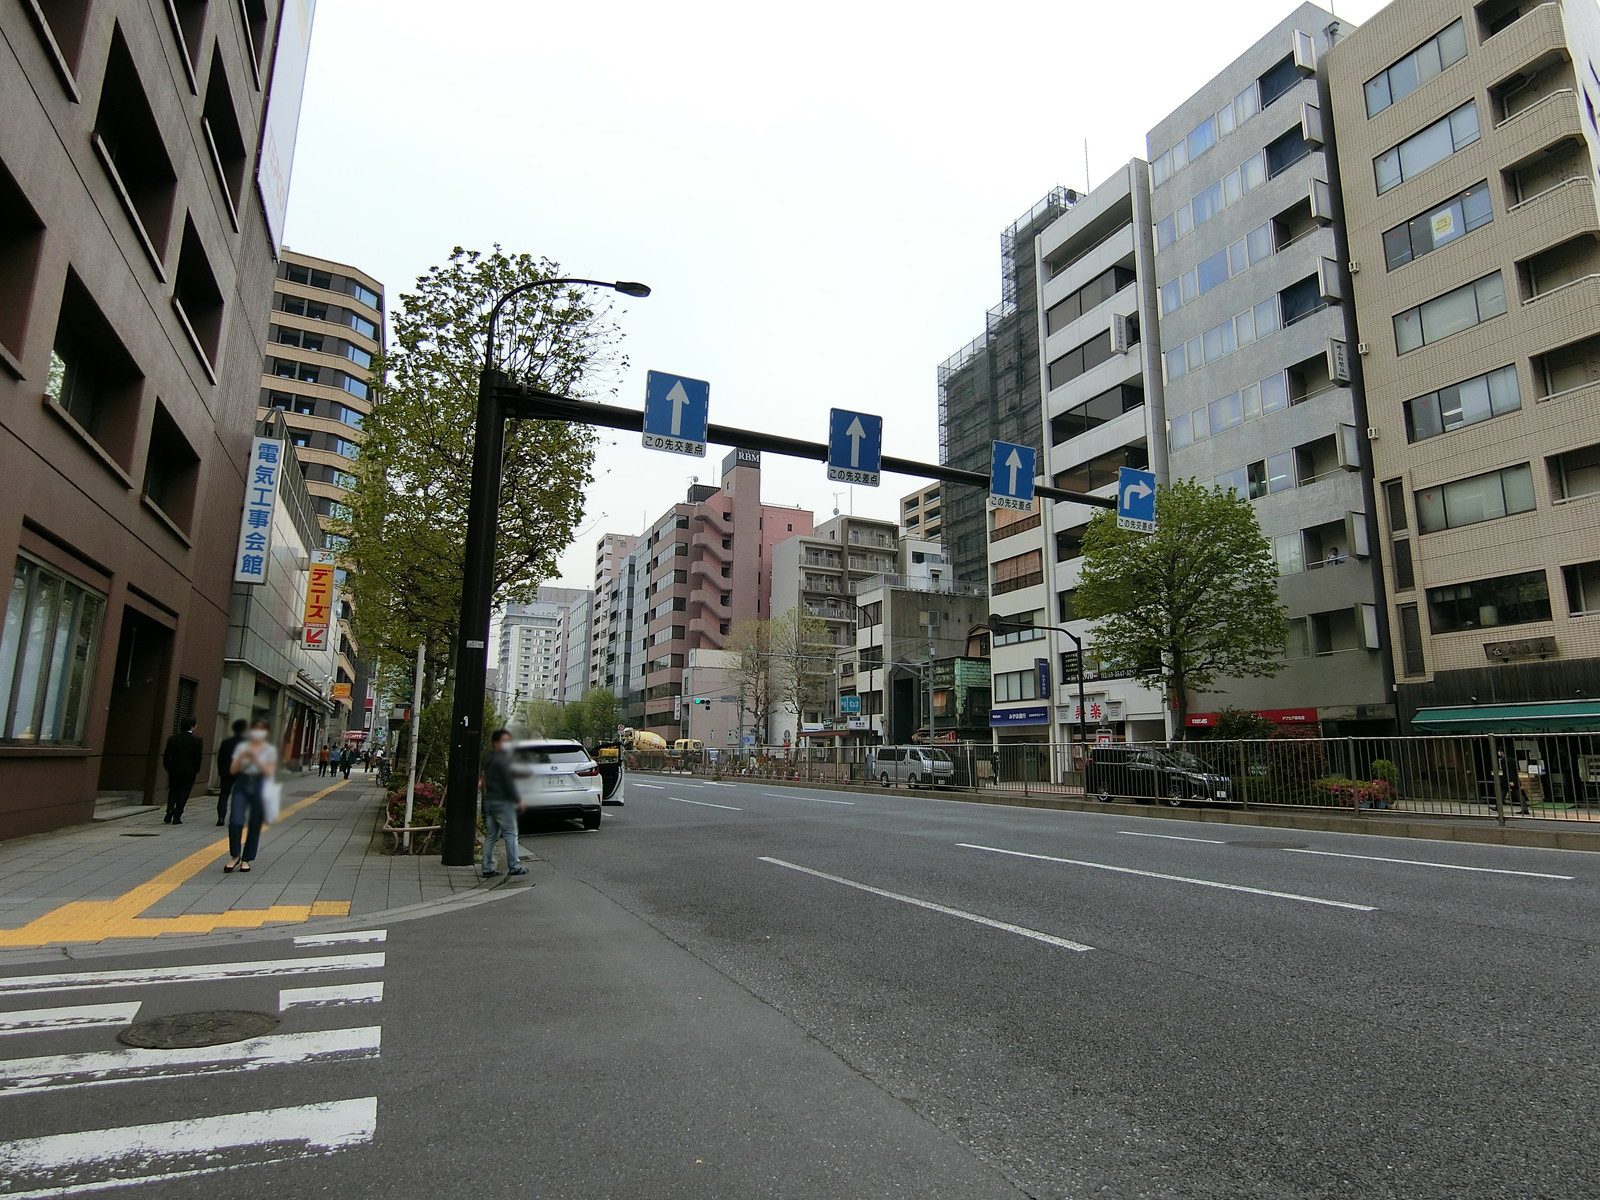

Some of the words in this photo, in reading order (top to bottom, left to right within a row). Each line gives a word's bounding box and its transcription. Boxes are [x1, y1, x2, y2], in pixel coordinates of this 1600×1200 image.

[268, 123, 285, 211] TEPCO
[644, 435, 703, 456] この先交差点
[738, 451, 760, 463] RBM
[829, 469, 878, 486] この先交差点
[241, 442, 279, 576] 電気工事会館
[990, 496, 1032, 511] この先交差点
[1118, 518, 1154, 532] この先交差点
[307, 568, 334, 619] デニーズ
